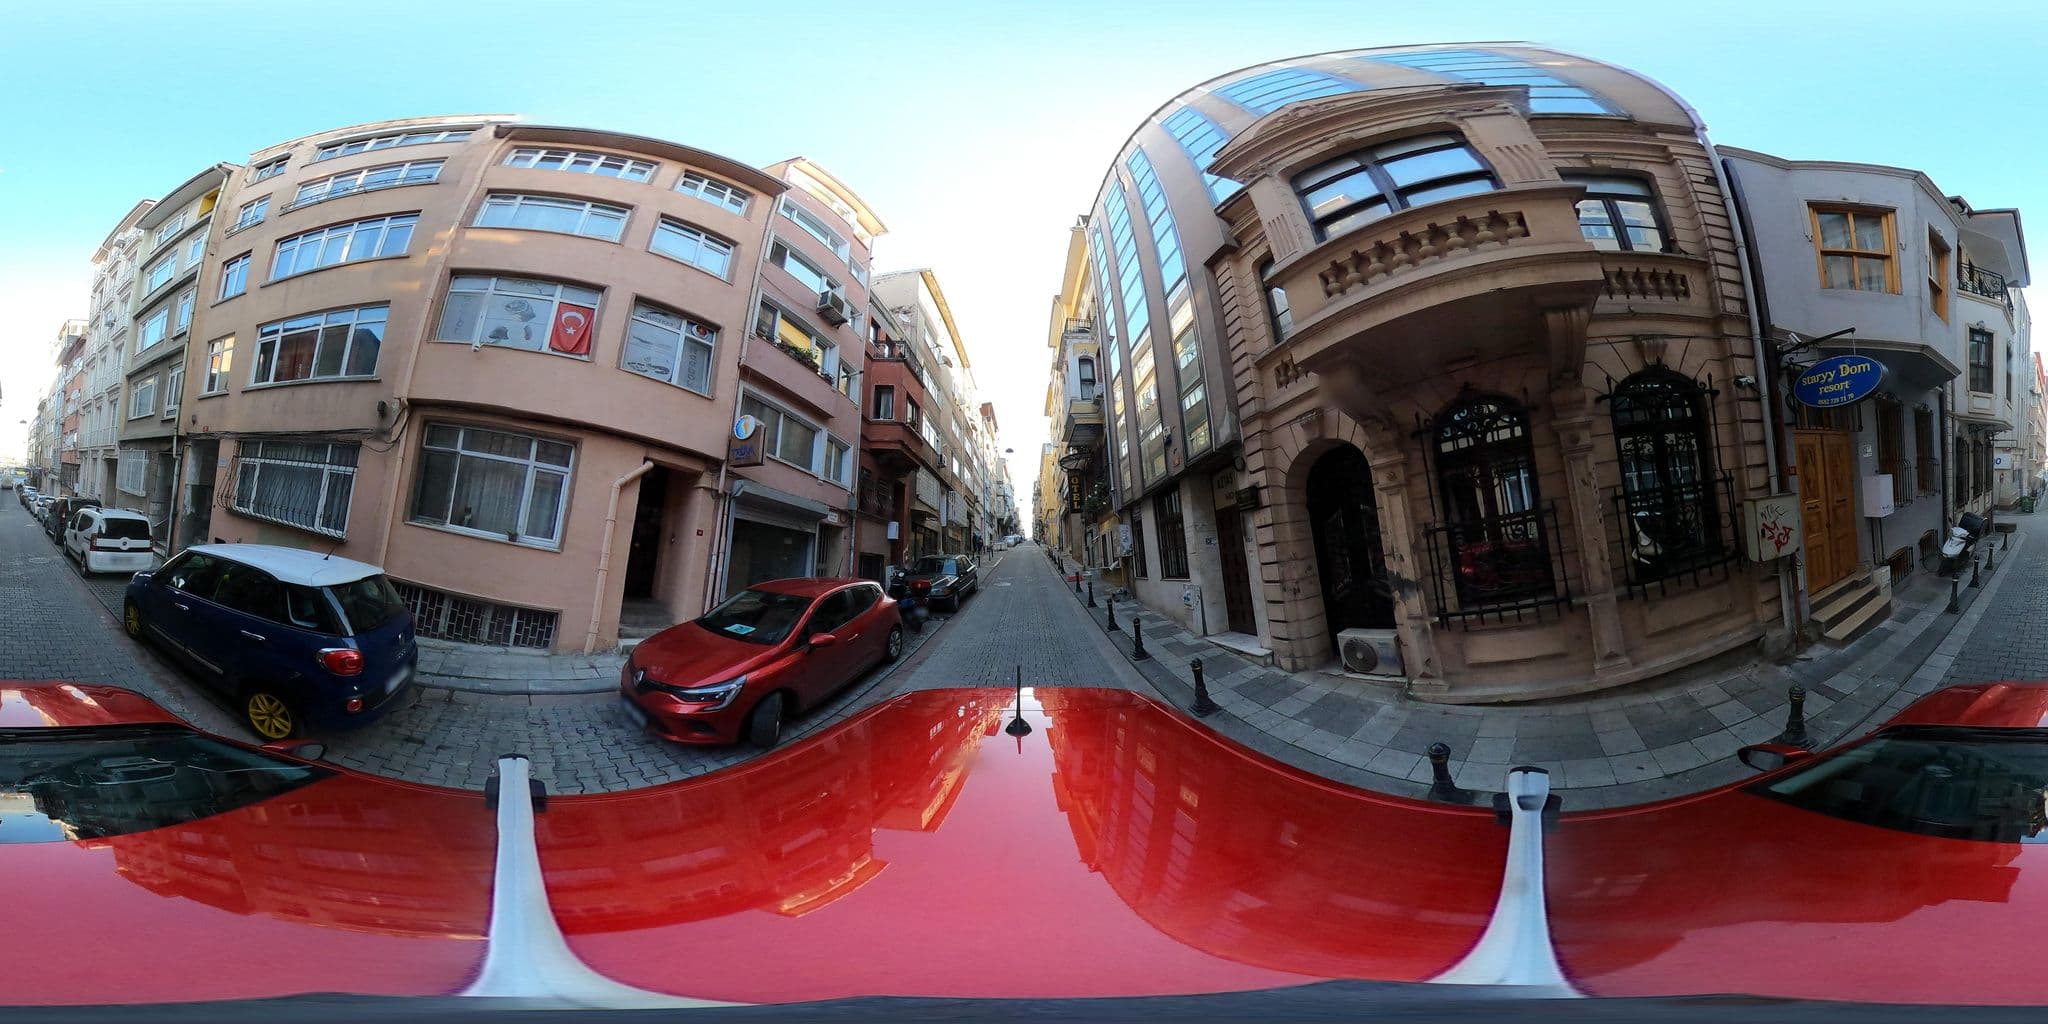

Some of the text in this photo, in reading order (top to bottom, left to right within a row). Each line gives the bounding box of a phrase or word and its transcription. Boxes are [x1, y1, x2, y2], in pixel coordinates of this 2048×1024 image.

[1840, 362, 1870, 377] Dom
[1819, 381, 1849, 394] resort
[1071, 476, 1080, 510] OTEL
